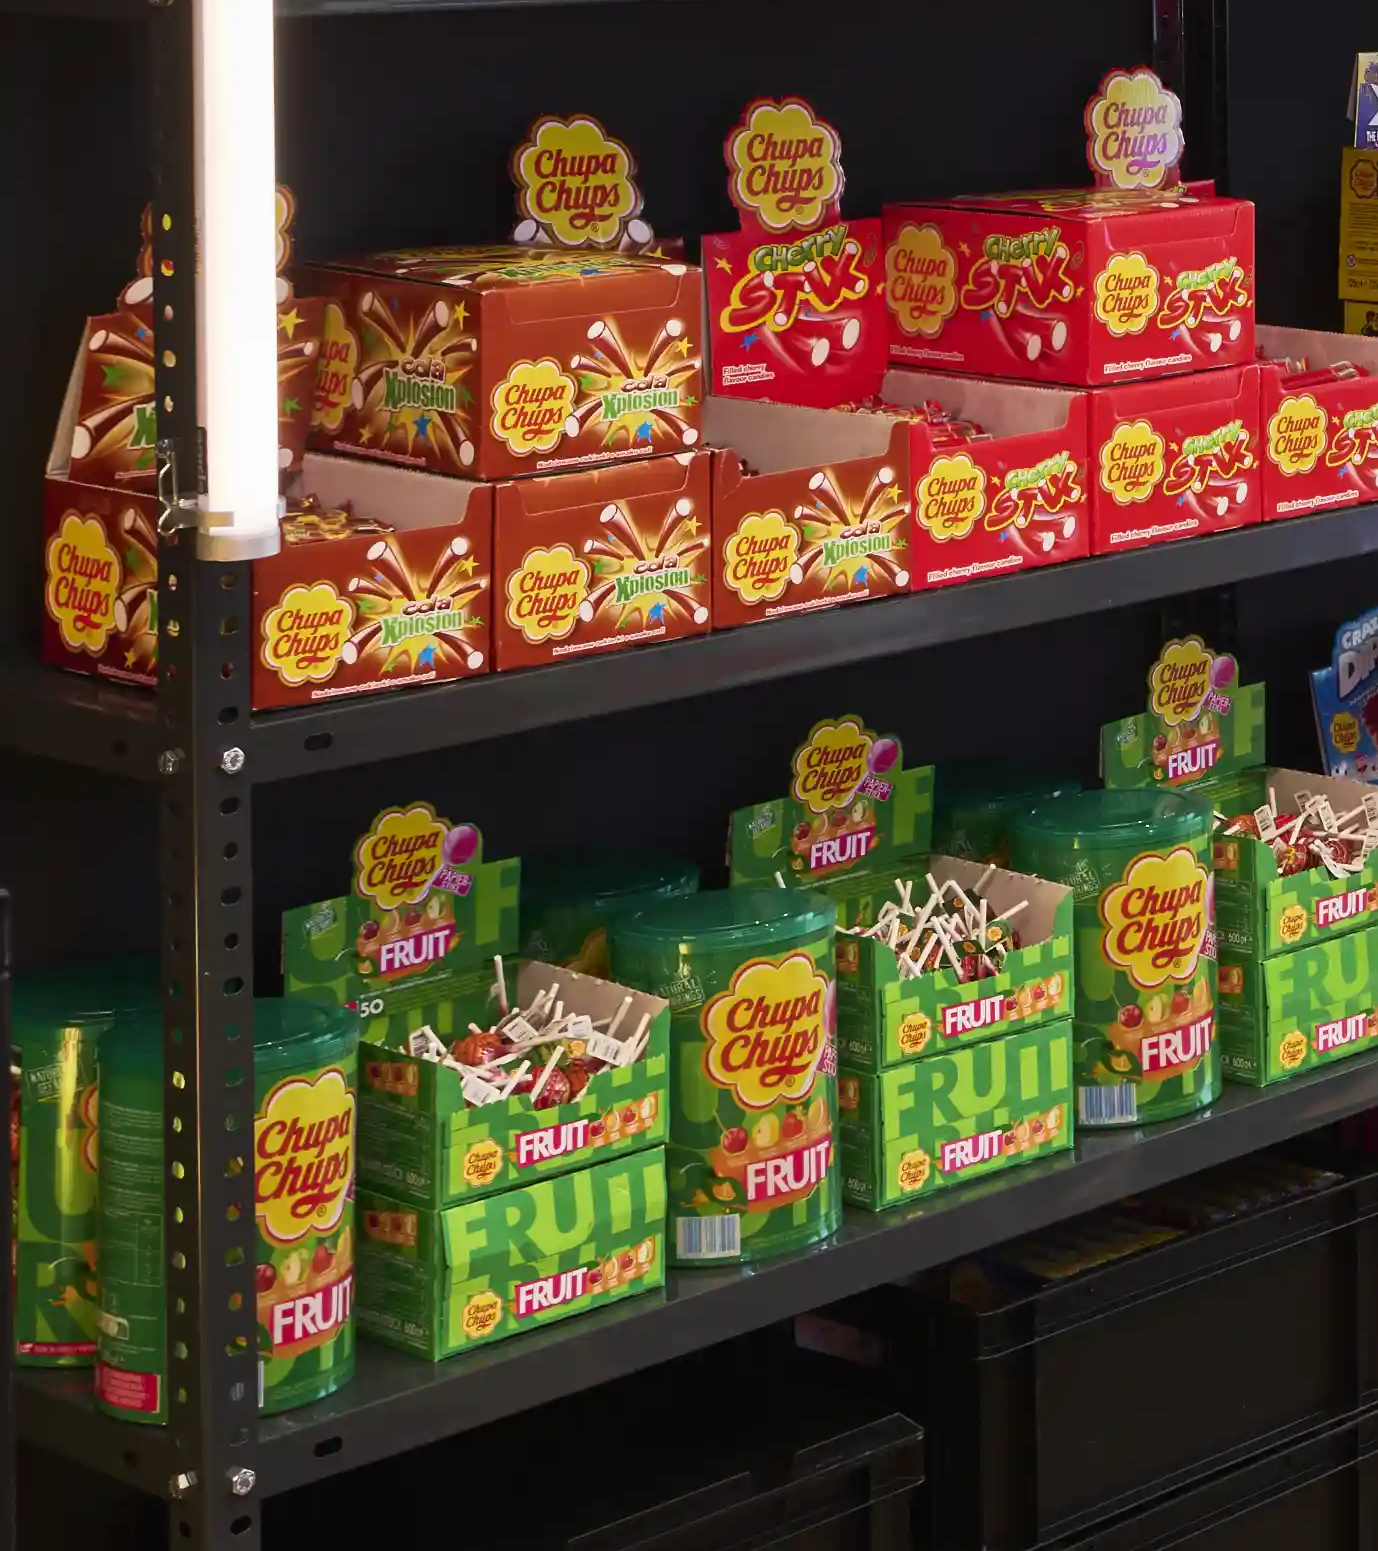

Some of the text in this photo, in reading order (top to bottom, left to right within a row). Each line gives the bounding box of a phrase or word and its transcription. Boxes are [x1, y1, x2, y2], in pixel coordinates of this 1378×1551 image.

[533, 148, 618, 182] Chupa
[534, 179, 621, 226] Chups
[601, 386, 679, 419] Xplosion
[620, 373, 669, 396] cola
[614, 567, 691, 602] Xplosion
[633, 555, 678, 575] cola
[401, 596, 452, 616] cola
[381, 608, 464, 646] Xplosion
[370, 830, 441, 865] Chupa
[809, 831, 871, 868] FRUIT
[367, 855, 438, 895] Chups
[1121, 882, 1204, 921] Chupa
[380, 924, 453, 974] FRUIT
[1116, 914, 1201, 964] Chups
[359, 998, 384, 1018] 50
[727, 992, 823, 1034] Chupa
[722, 1030, 819, 1085] Chups
[1140, 1014, 1213, 1072] FRUIT
[517, 1119, 588, 1165] FRUIT
[746, 1141, 831, 1199] FRUIT
[517, 1267, 587, 1313] FRUIT
